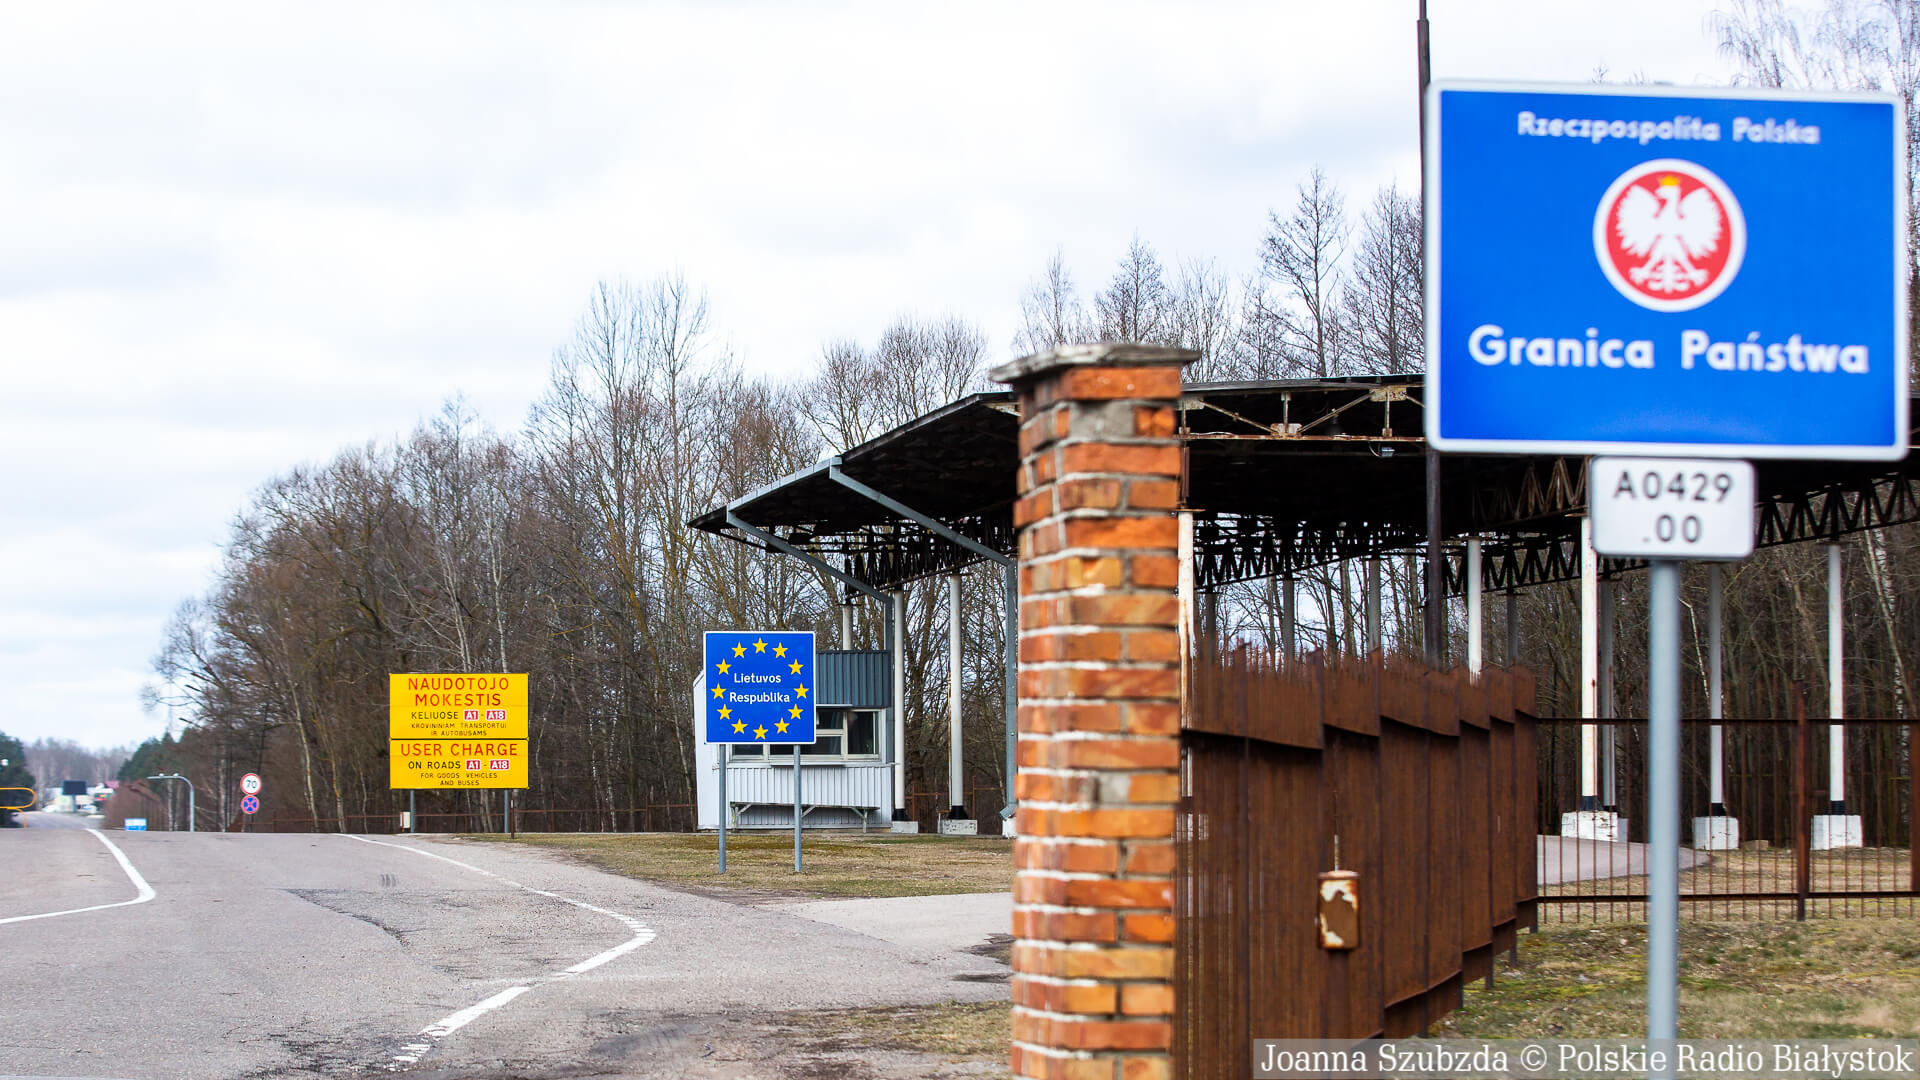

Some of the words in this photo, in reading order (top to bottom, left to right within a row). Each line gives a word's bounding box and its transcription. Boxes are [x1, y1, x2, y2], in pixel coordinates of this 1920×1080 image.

[1517, 111, 1721, 145] Rzeczpospolita
[1732, 117, 1821, 145] Polska
[1468, 324, 1655, 369] Granica
[1681, 329, 1869, 374] Państwa
[1613, 471, 1734, 502] A0429
[408, 677, 509, 690] NAUDOTOJO
[734, 673, 782, 684] Lietuvos
[415, 693, 501, 706] MOKESTIS
[729, 691, 790, 704] Respublika
[411, 711, 459, 719] KELIUOSE
[465, 711, 477, 719] A1
[486, 711, 504, 719] A18
[400, 744, 442, 756] USER
[450, 743, 518, 756] CHARGE
[408, 761, 422, 769] ON
[427, 761, 461, 769] ROADS
[466, 760, 479, 769] A1
[490, 760, 508, 769] A18
[245, 779, 257, 788] 70
